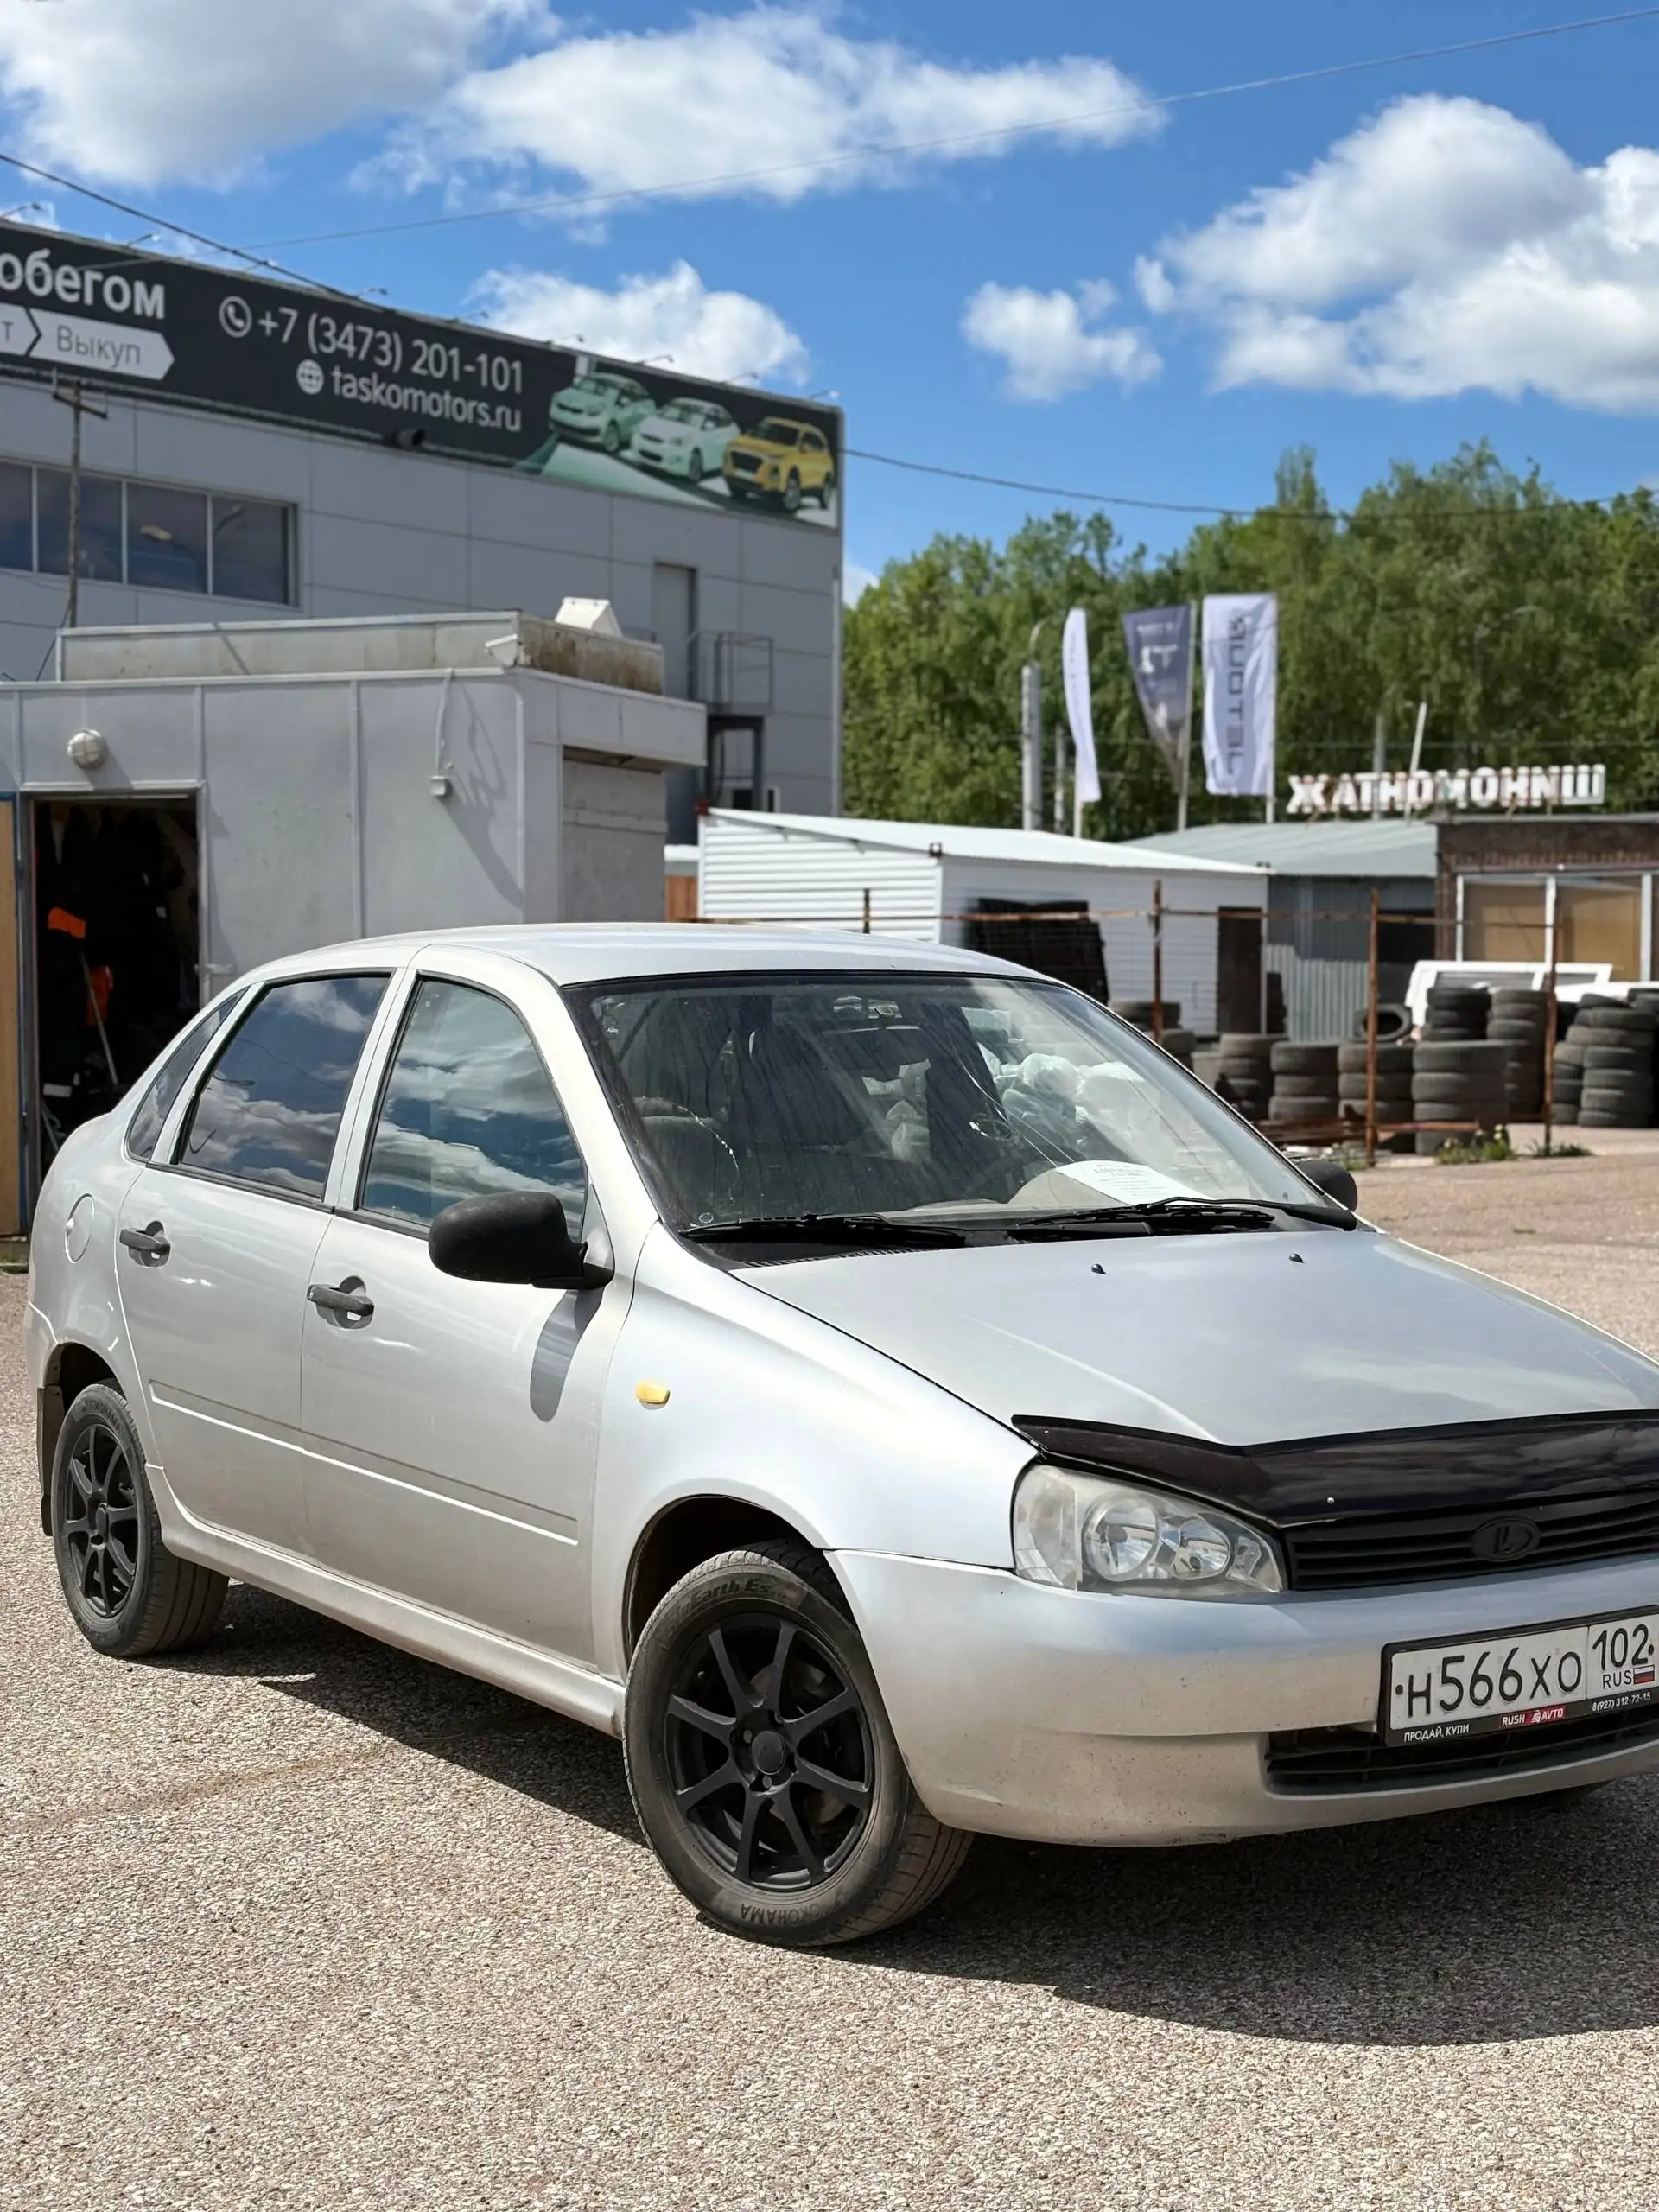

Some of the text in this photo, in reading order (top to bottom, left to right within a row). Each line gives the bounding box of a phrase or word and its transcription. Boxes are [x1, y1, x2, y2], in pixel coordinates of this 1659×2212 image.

[0, 247, 166, 320] обегом
[57, 324, 142, 369] Выкуп
[258, 306, 523, 394] +7 (3473) 201-101
[332, 366, 523, 432] taskomotors.ru
[1408, 1624, 1649, 1717] Н566ХО 102
[1602, 1669, 1632, 1689] RUS
[1446, 1724, 1470, 1737] КУПИ
[1502, 1713, 1525, 1726] RUSH
